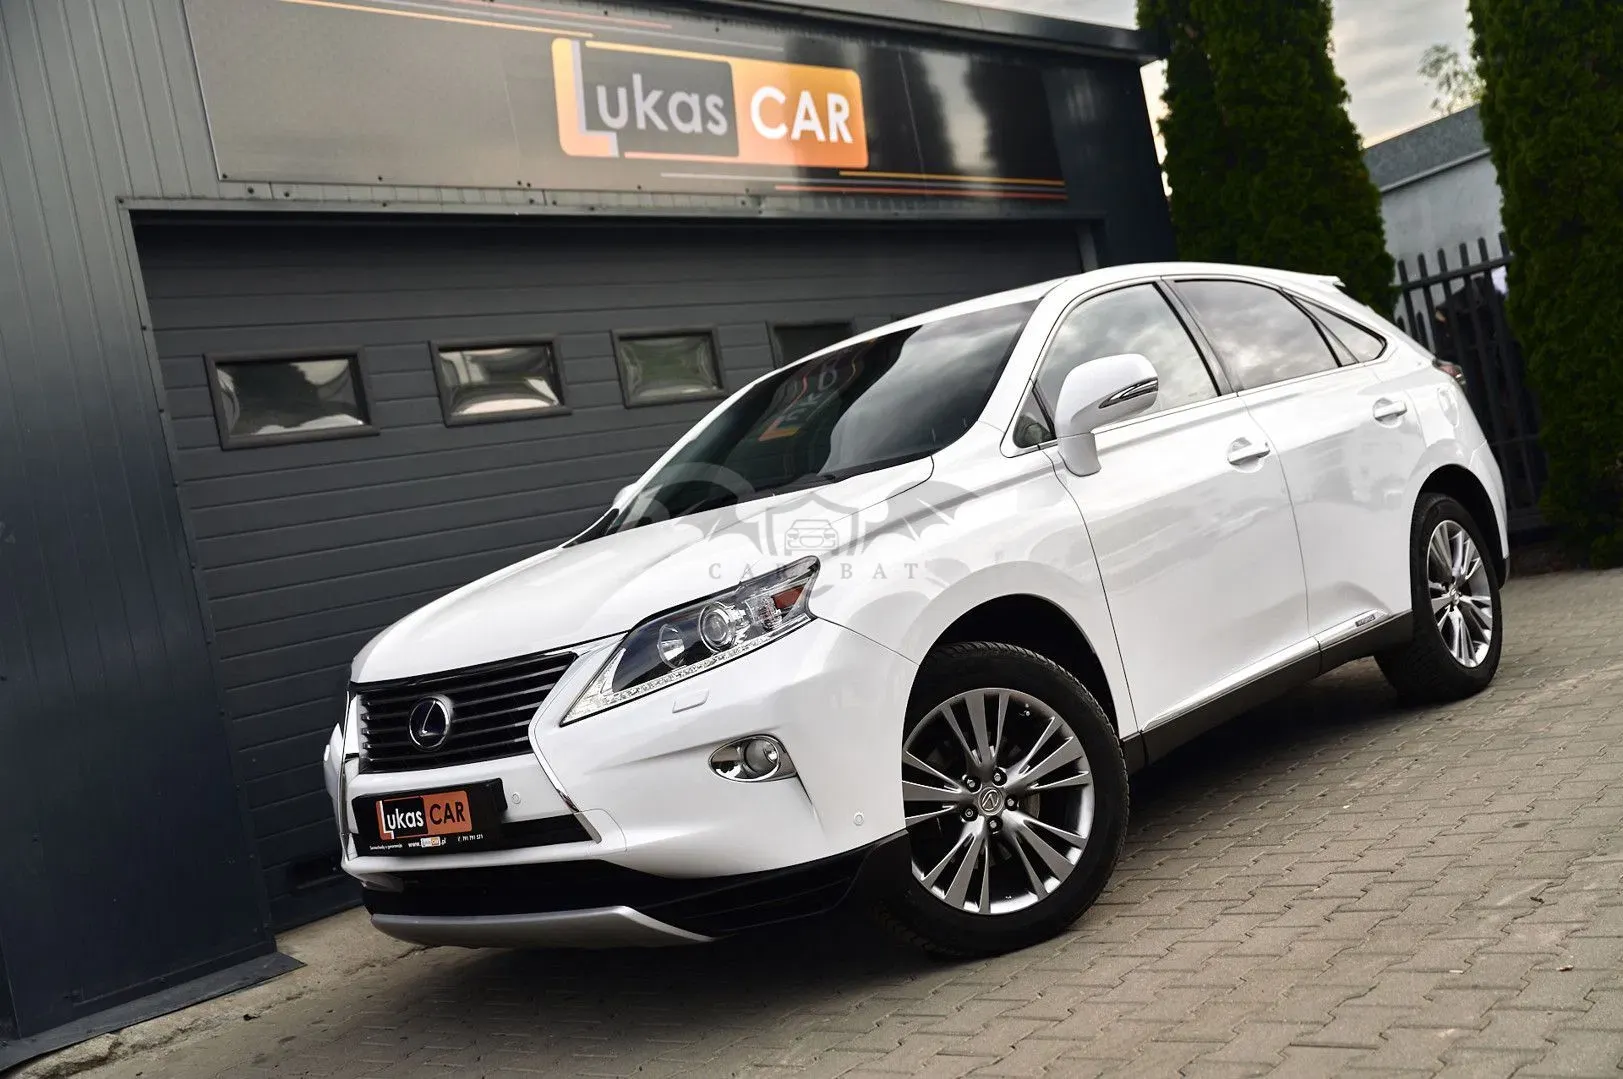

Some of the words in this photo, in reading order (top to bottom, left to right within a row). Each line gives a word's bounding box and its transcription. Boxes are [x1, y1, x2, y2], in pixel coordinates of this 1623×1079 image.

[552, 38, 729, 157] Lukas
[750, 85, 853, 144] CAR
[376, 800, 425, 840] Lukas
[429, 801, 466, 826] CAR
